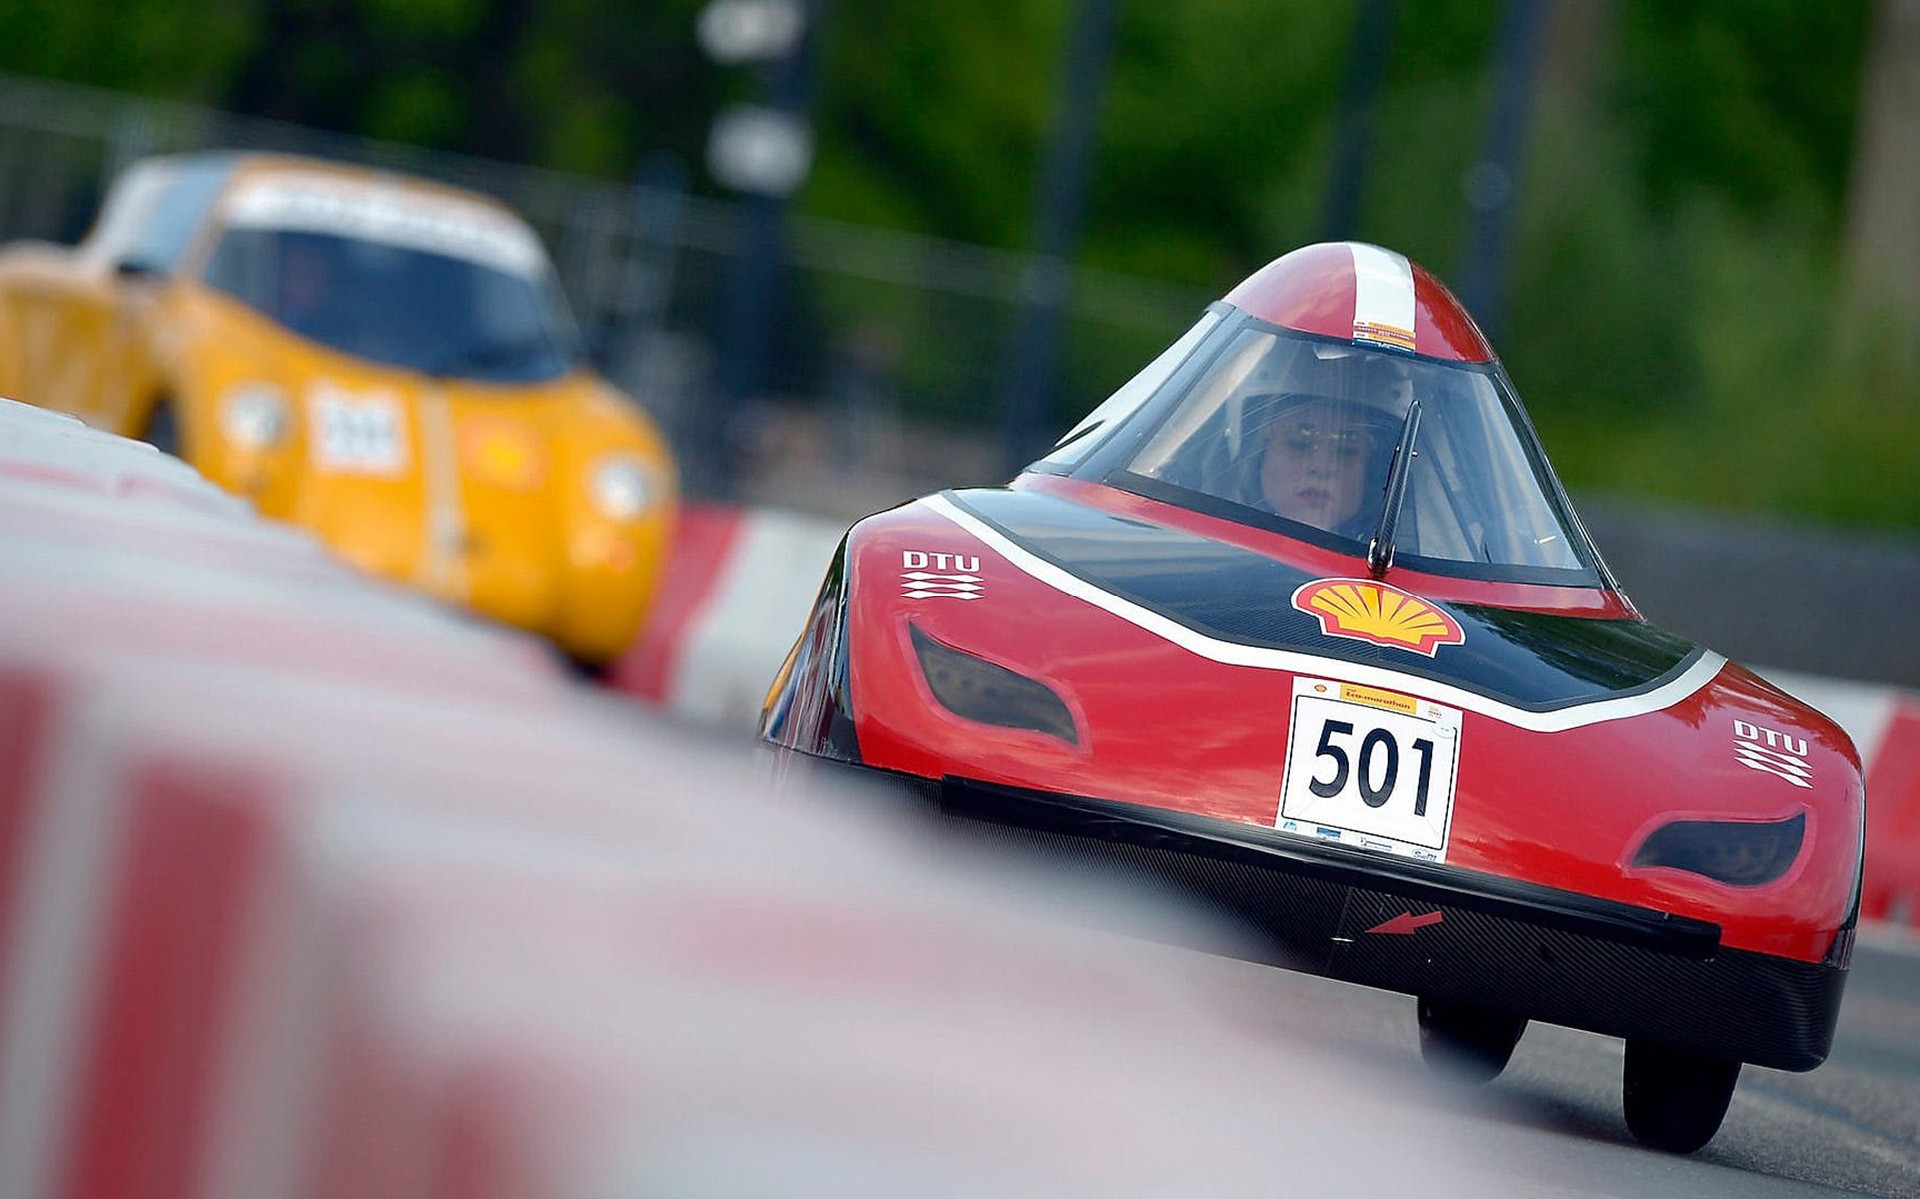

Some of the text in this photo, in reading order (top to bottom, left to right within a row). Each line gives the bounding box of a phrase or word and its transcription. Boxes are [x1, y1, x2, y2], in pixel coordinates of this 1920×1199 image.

[903, 550, 980, 572] DTU
[1345, 691, 1411, 710] Eco-marathon
[1733, 719, 1808, 757] DTU
[1308, 718, 1434, 818] 501
